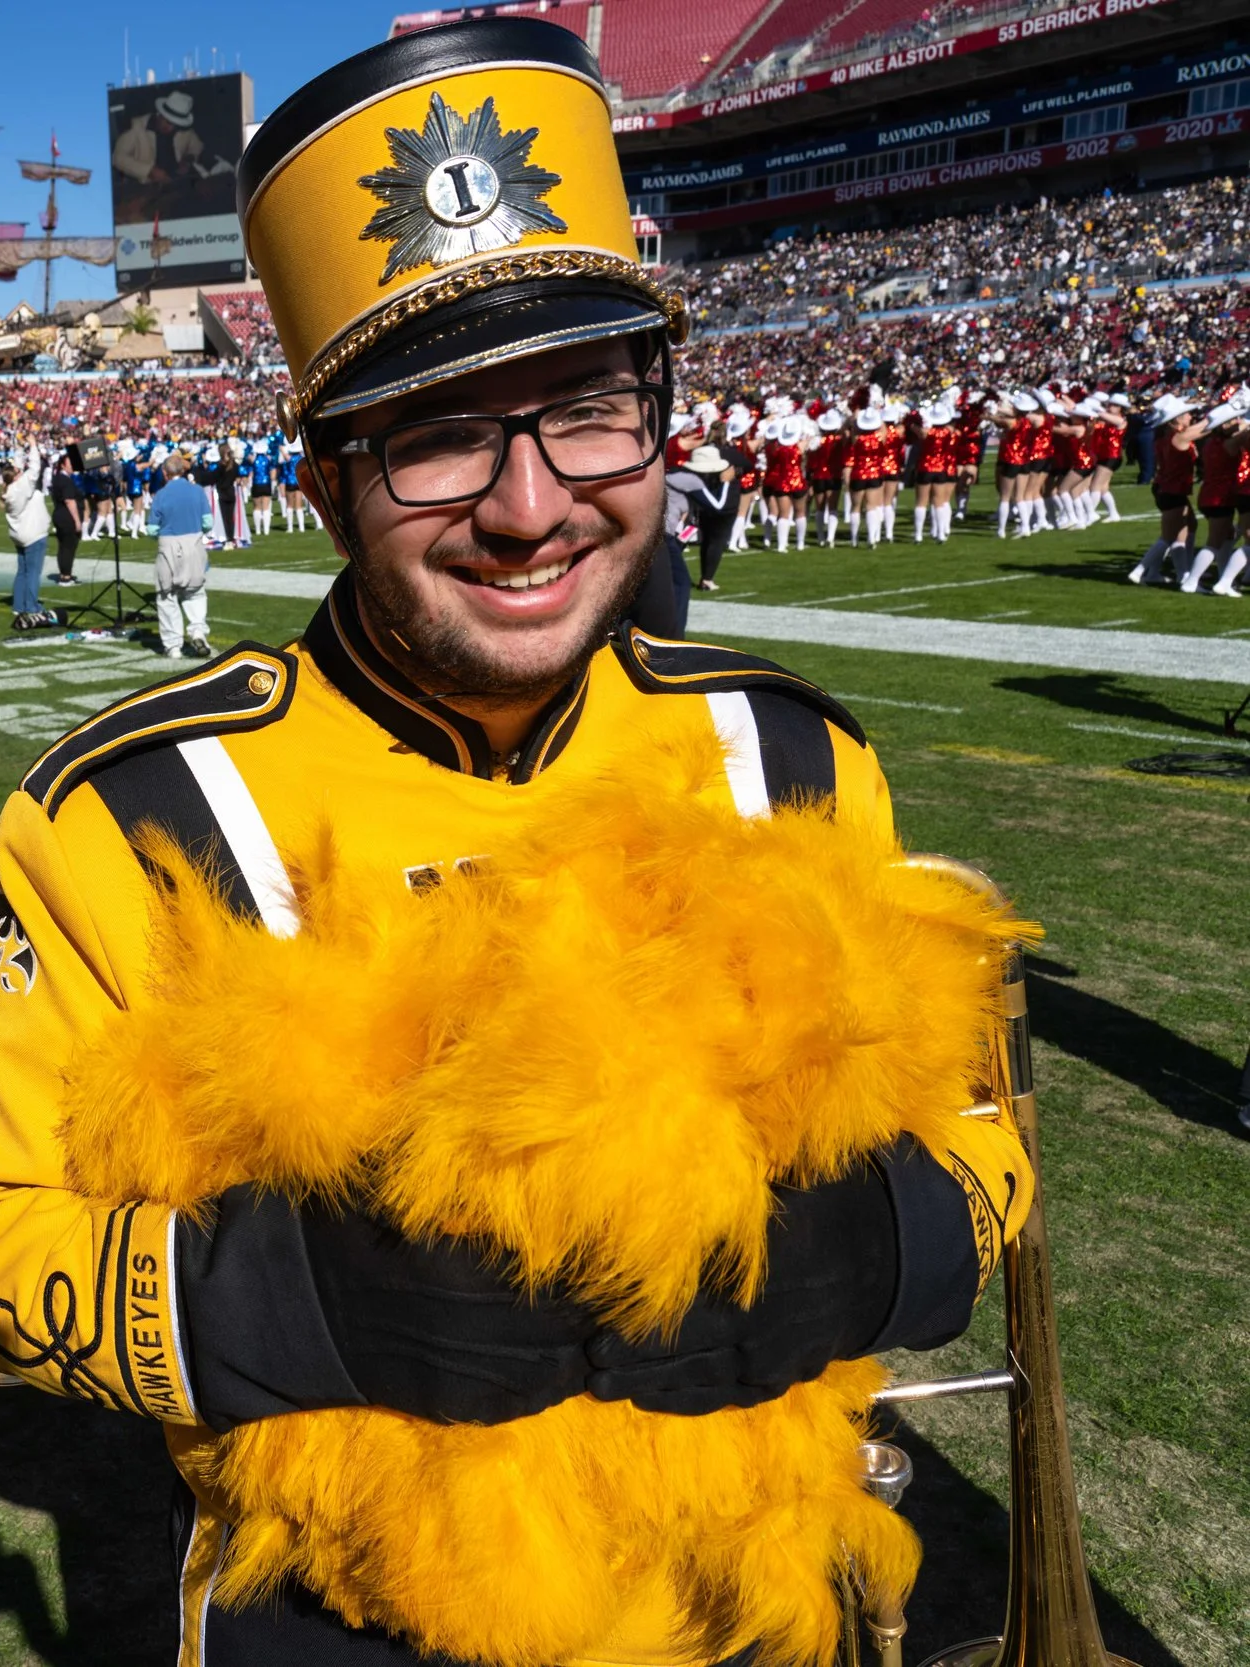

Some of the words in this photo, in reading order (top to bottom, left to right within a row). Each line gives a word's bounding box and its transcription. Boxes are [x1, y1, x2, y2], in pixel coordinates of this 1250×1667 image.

[998, 25, 1018, 43] 55
[1021, 3, 1101, 37] DERRICK
[830, 69, 847, 84] 40
[849, 59, 885, 79] MIKE
[887, 40, 956, 70] ALSTOTT
[702, 104, 715, 117] 47
[717, 91, 751, 113] JOHN
[754, 82, 796, 104] LYNCH
[1022, 101, 1044, 114] LIFE
[1047, 94, 1075, 108] WELL
[612, 116, 644, 132] BER
[878, 121, 944, 146] RAYMOND
[945, 110, 991, 132] JAMES
[1165, 118, 1214, 143] 2020
[642, 171, 708, 190] RAYMOND
[709, 163, 743, 180] JAMES
[766, 157, 783, 168] LIFE
[784, 151, 805, 164] WELL
[835, 180, 884, 203] SUPER
[889, 172, 935, 193] BOWL
[939, 151, 1042, 184] CHAMPIONS
[1066, 139, 1109, 160] 2002
[444, 161, 480, 217] I
[205, 231, 239, 245] Group
[131, 1251, 181, 1417] HAWKEYES
